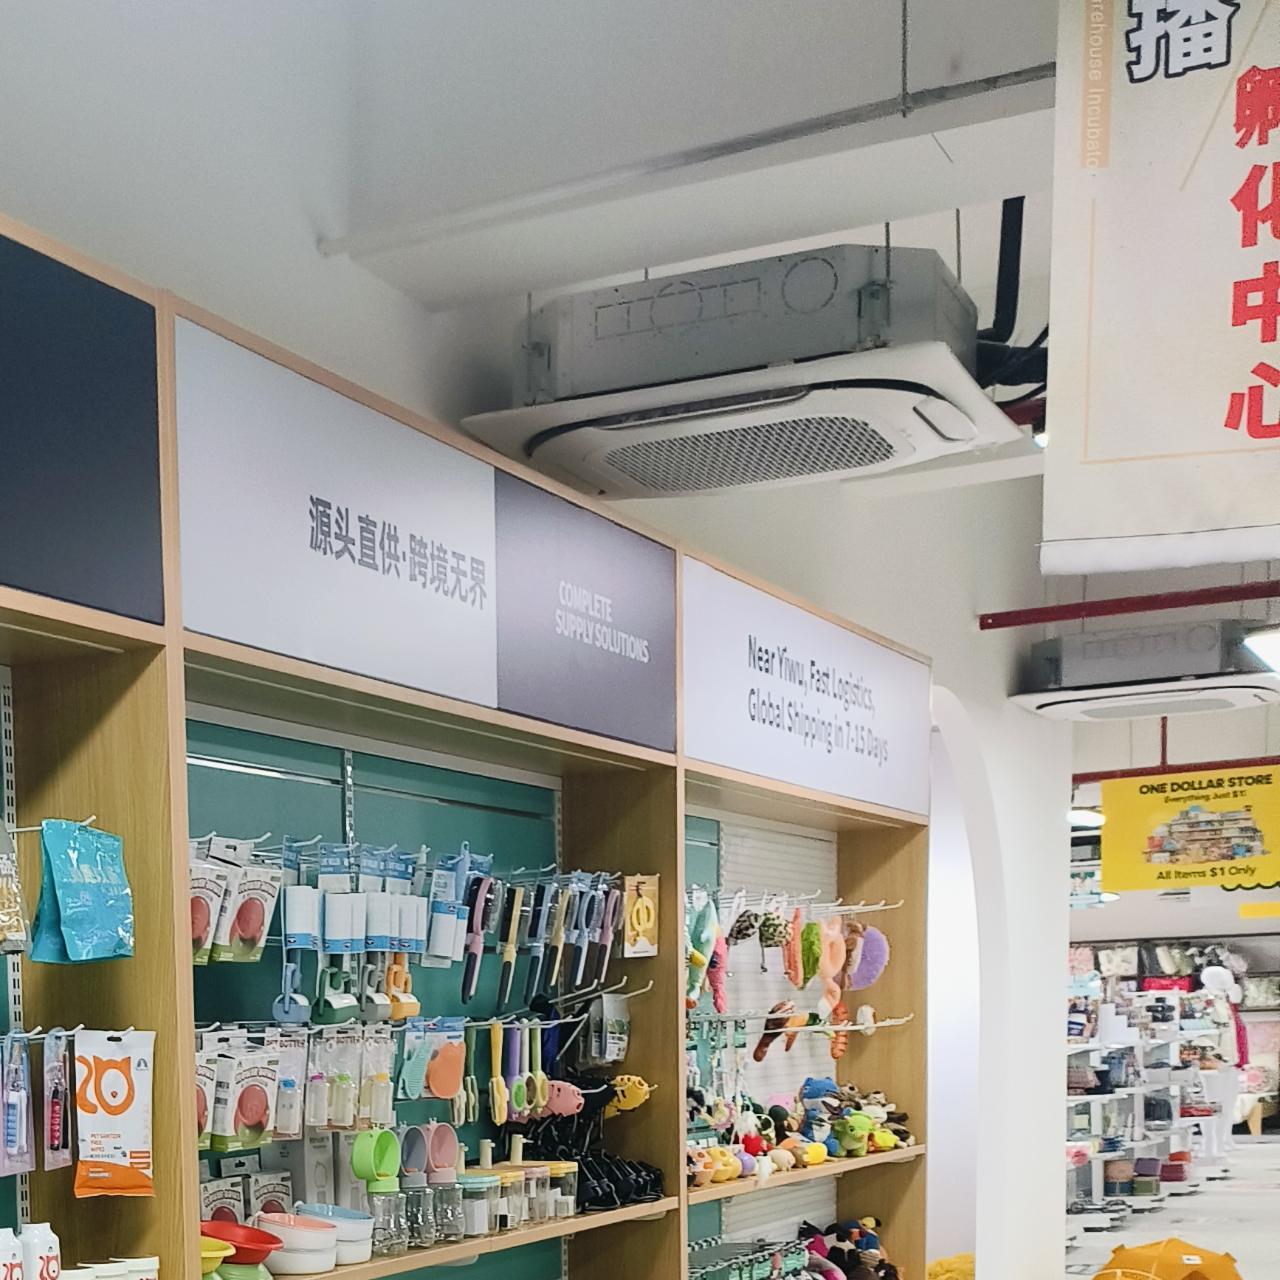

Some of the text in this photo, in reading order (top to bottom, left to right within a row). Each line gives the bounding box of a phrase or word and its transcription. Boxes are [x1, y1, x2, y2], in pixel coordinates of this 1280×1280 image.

[558, 579, 613, 624] COMPLETE
[555, 608, 650, 664] SUPPLY SOLUTIONS
[748, 634, 775, 676] Near
[810, 659, 831, 697] Fast
[748, 688, 785, 731] Global
[787, 701, 833, 754] Shipping
[834, 714, 844, 749] in
[867, 727, 889, 768] Days
[1139, 773, 1273, 795] ONE DOLLAR STORE
[1156, 864, 1257, 880] All Items $1 Only
